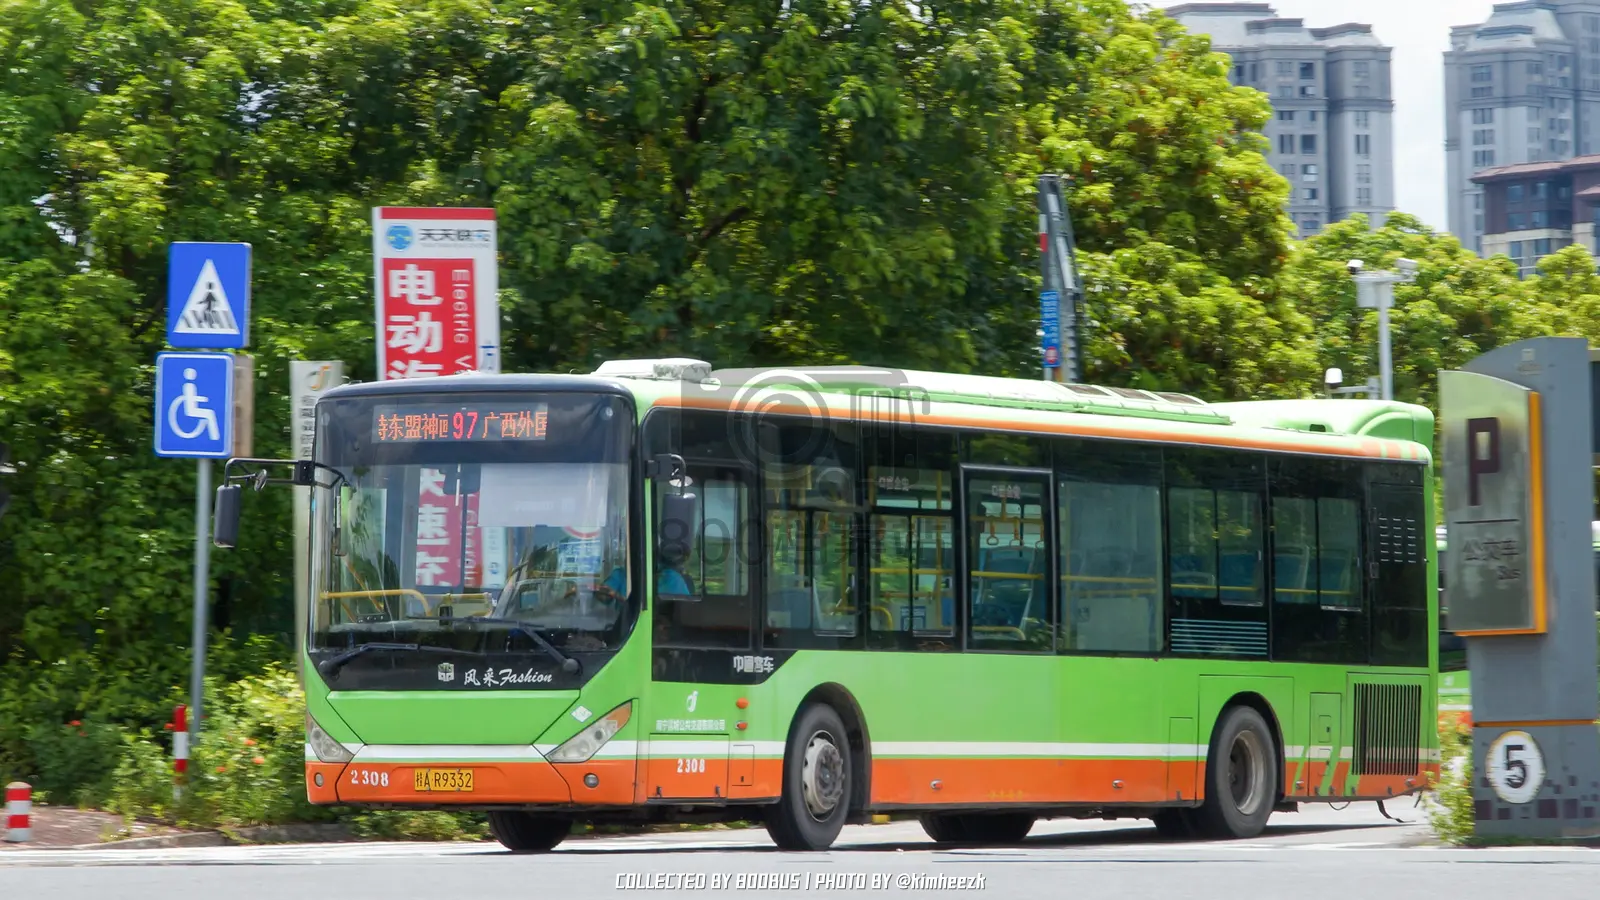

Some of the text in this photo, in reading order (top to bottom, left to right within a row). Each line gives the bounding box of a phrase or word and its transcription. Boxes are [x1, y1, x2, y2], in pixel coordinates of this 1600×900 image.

[453, 411, 478, 439] 97
[1467, 417, 1499, 506] P
[733, 655, 775, 674] 中国客车
[676, 758, 706, 774] 2308
[1506, 744, 1527, 789] 5
[350, 769, 389, 788] 2308
